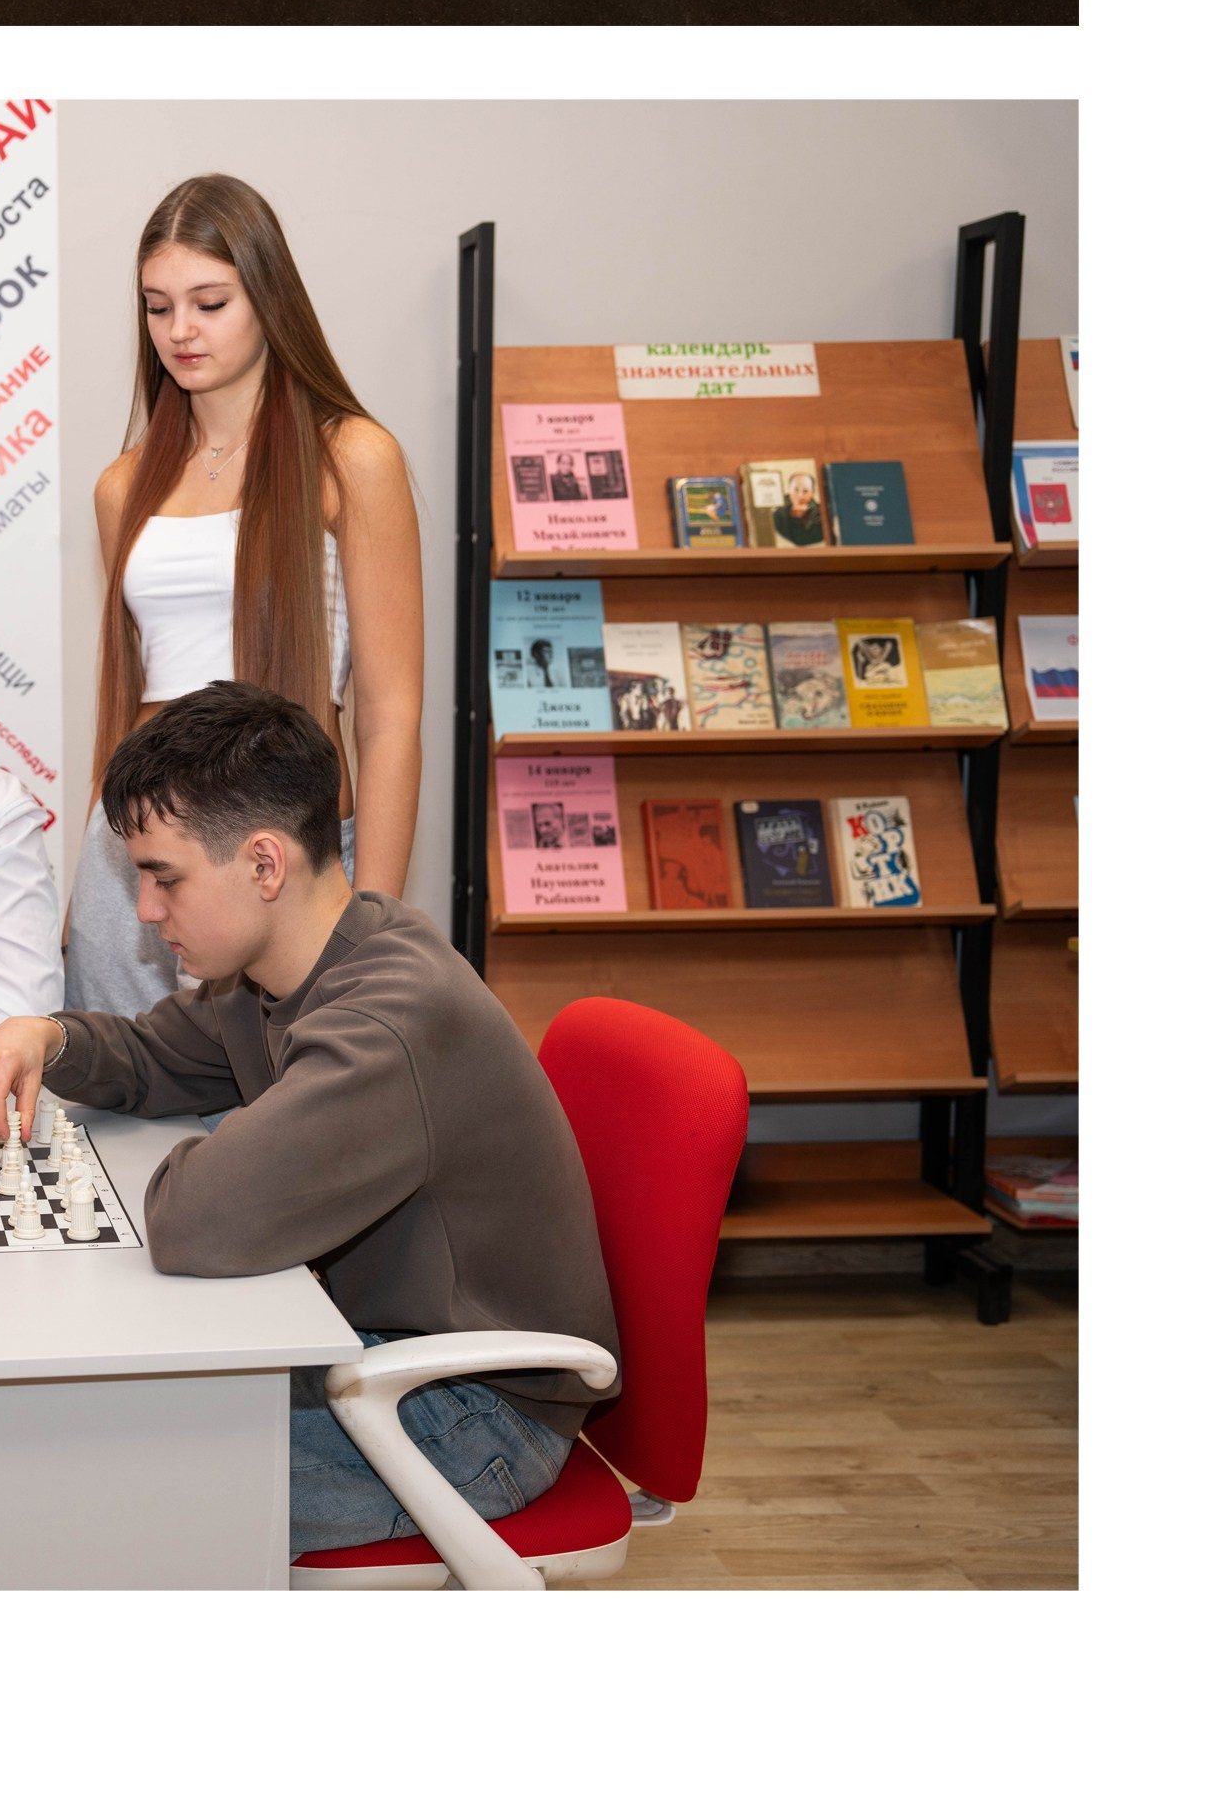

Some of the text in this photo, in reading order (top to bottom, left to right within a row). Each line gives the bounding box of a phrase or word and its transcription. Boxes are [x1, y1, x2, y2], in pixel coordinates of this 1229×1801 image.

[646, 344, 771, 359] календарь
[617, 362, 816, 379] знаменательных
[696, 381, 736, 397] дат
